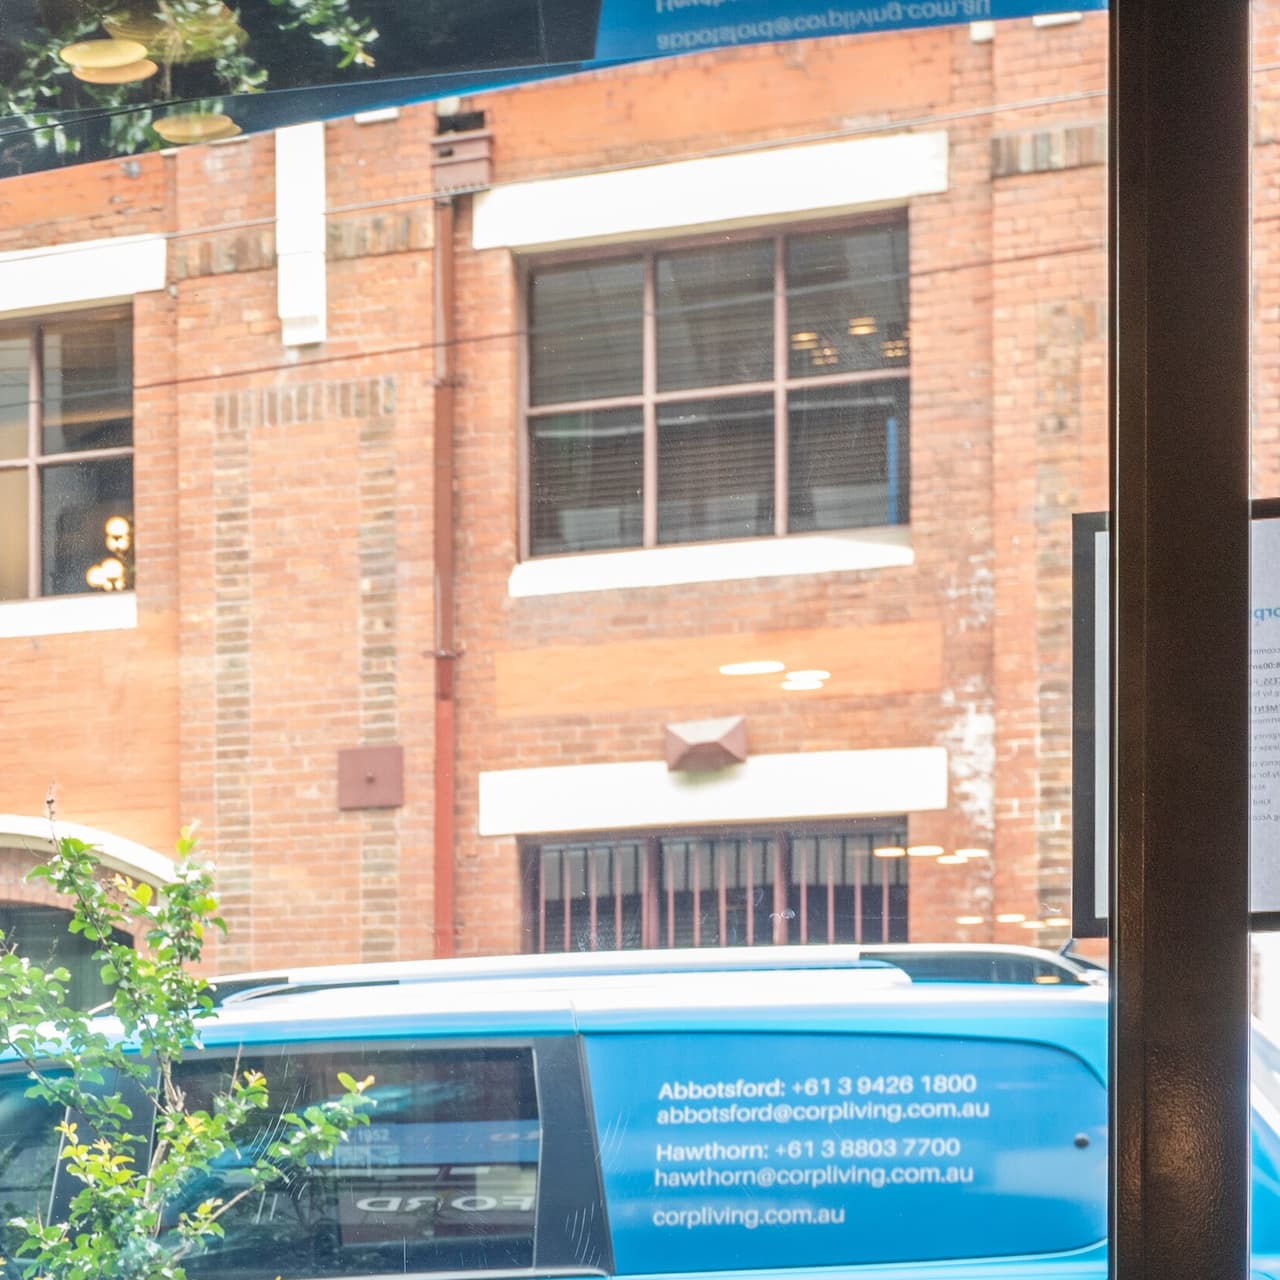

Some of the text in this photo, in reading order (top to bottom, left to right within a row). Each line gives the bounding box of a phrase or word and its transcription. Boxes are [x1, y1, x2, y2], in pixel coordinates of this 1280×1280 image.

[658, 1074, 977, 1100] Abbotsford: +61 3 9426 1800
[657, 1102, 989, 1125] abbotsford@corpliving.com.au
[656, 1138, 960, 1161] Hawthorn: +61 3 8803 7700
[654, 1165, 974, 1188] hawthorn@corpliving.com.au
[652, 1207, 845, 1229] corpliving.com.au
